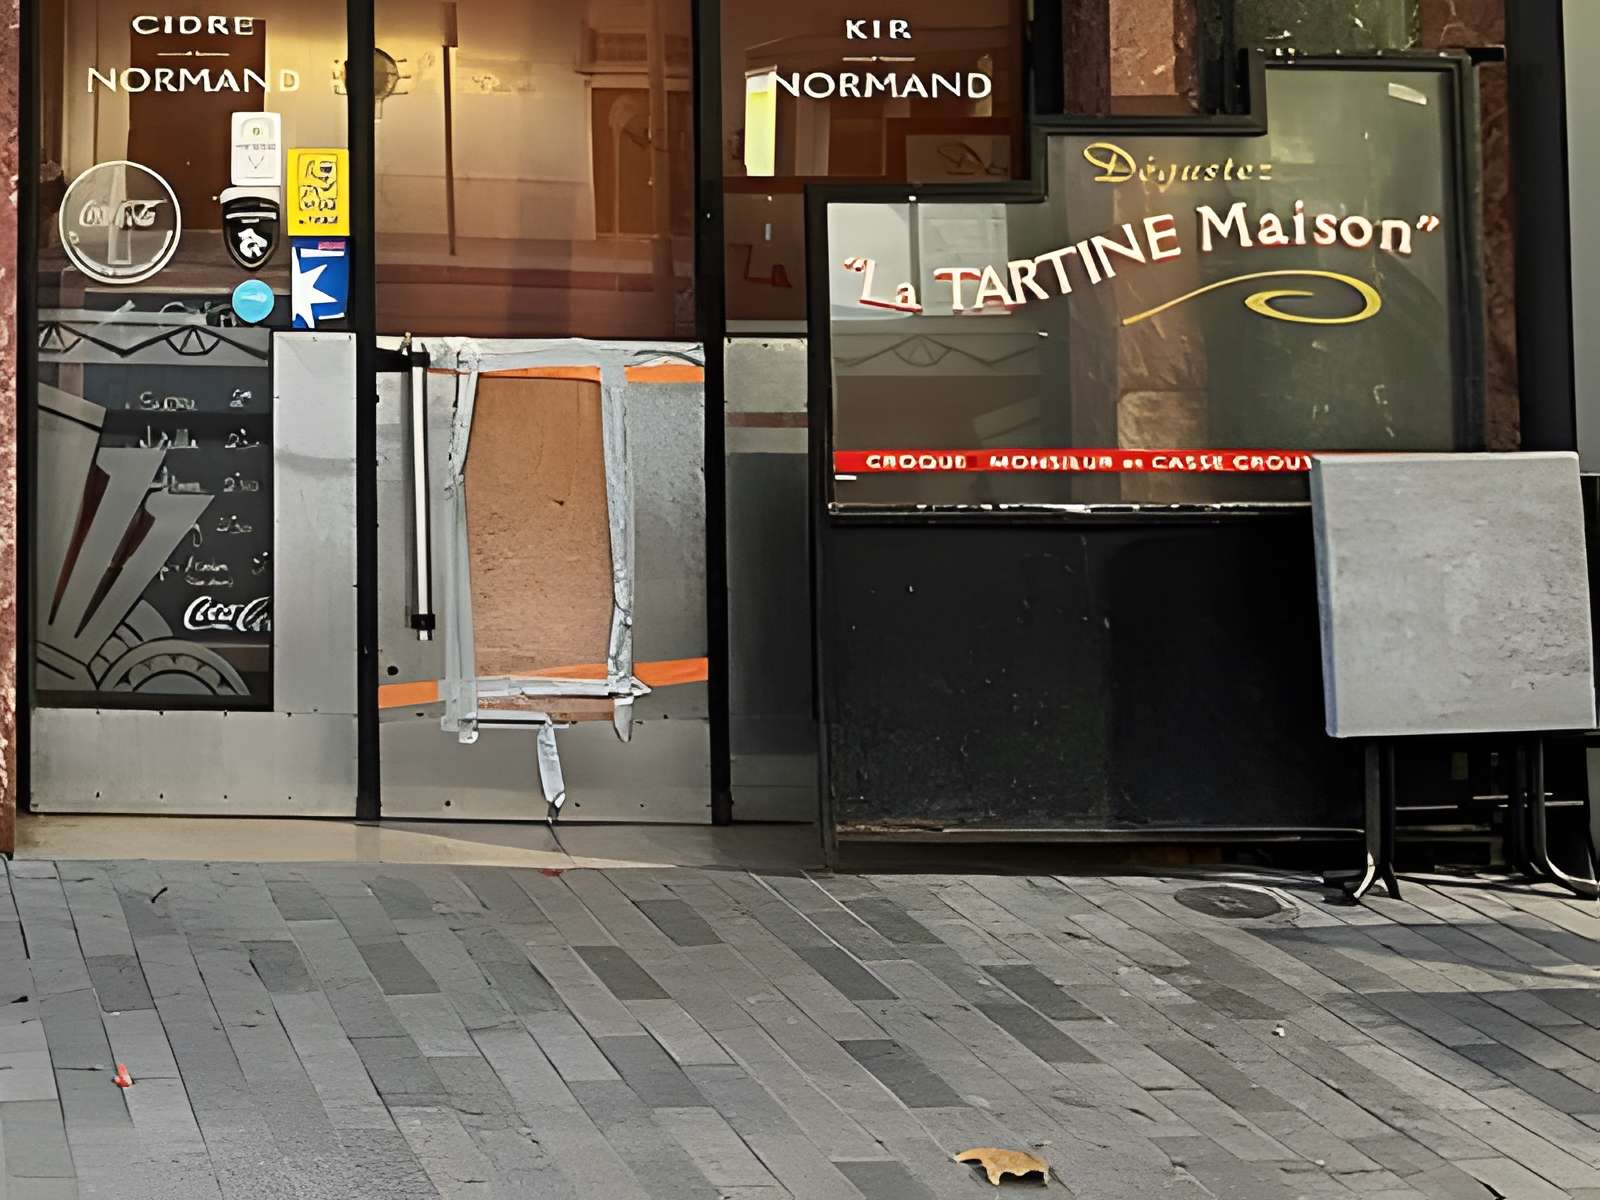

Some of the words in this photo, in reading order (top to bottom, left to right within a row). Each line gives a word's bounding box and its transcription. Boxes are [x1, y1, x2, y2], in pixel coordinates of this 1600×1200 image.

[132, 15, 254, 36] CIDRE
[845, 19, 912, 39] KIR
[87, 67, 300, 93] NORMAND
[768, 71, 992, 99] NORMAND
[933, 213, 1182, 312] TARTINE
